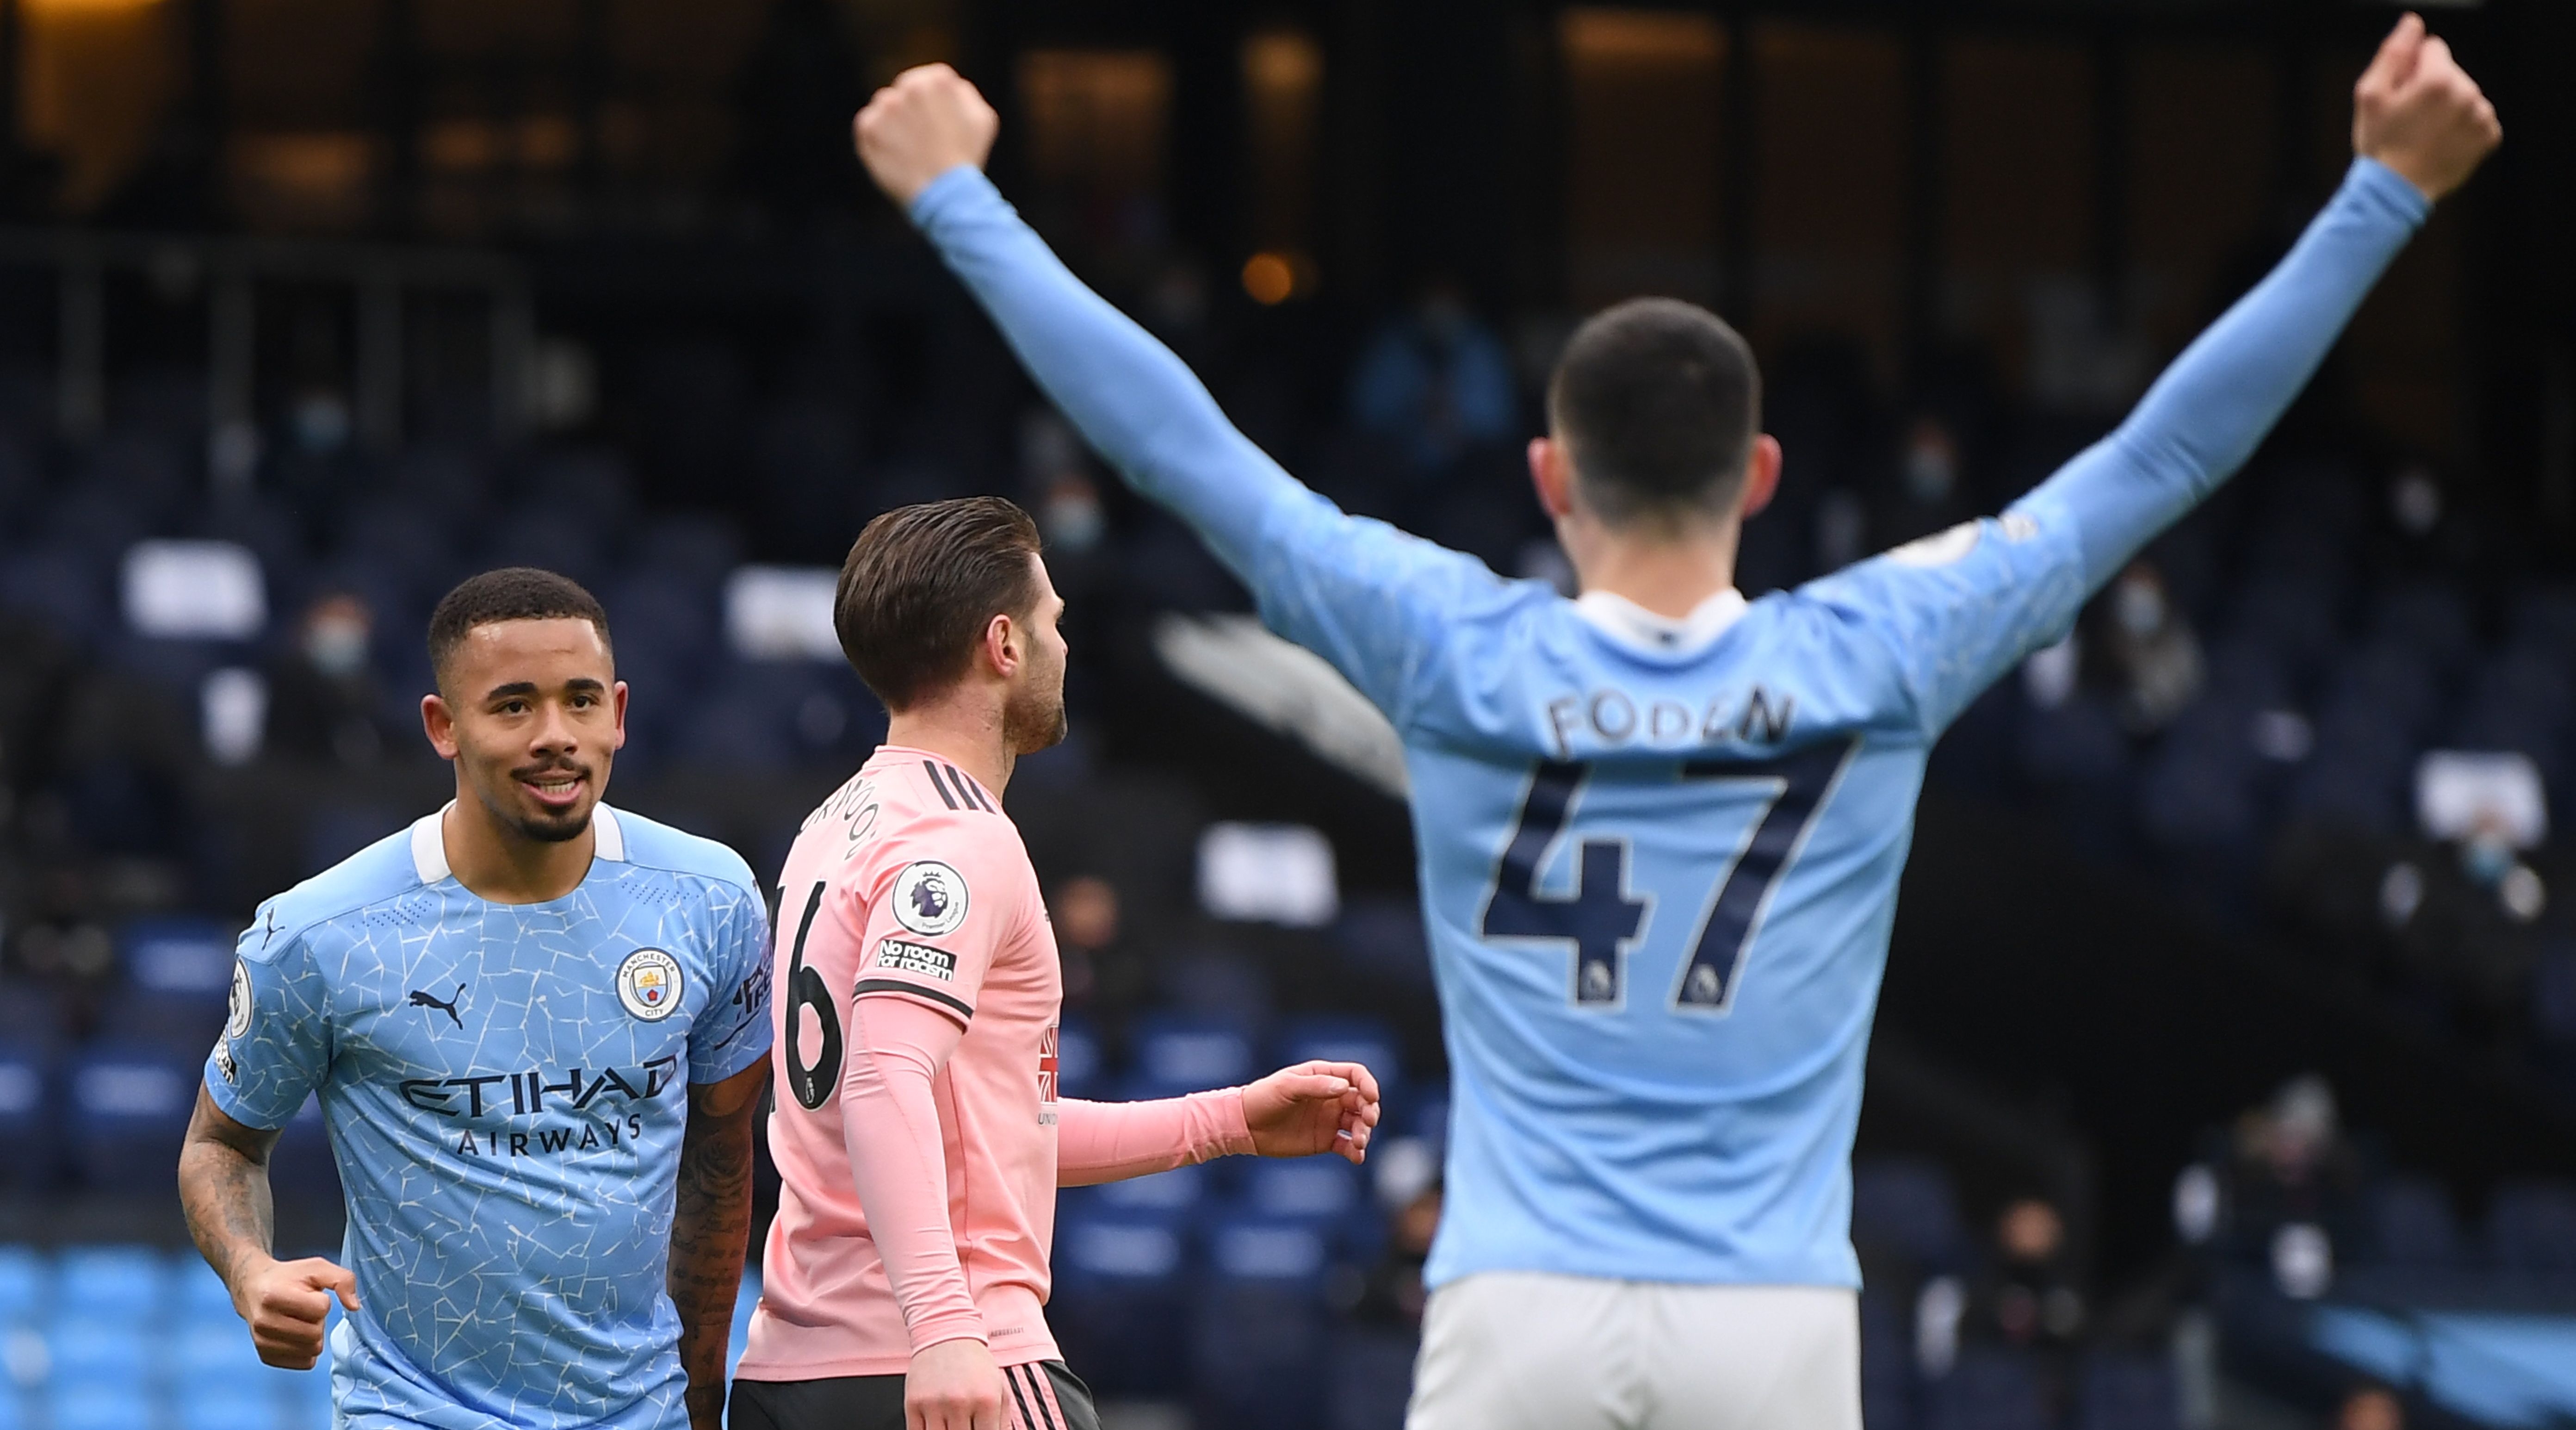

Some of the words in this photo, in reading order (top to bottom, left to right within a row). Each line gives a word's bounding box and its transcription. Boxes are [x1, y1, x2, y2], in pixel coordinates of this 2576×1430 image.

[1477, 735, 1861, 1011] 47
[622, 953, 675, 978] MANCHESTER
[879, 939, 903, 955] No
[904, 945, 949, 967] room
[899, 958, 954, 982] racism
[645, 1008, 664, 1017] CITY
[399, 1054, 676, 1118] ETIHAD
[456, 1113, 641, 1157] AIRWAYS
